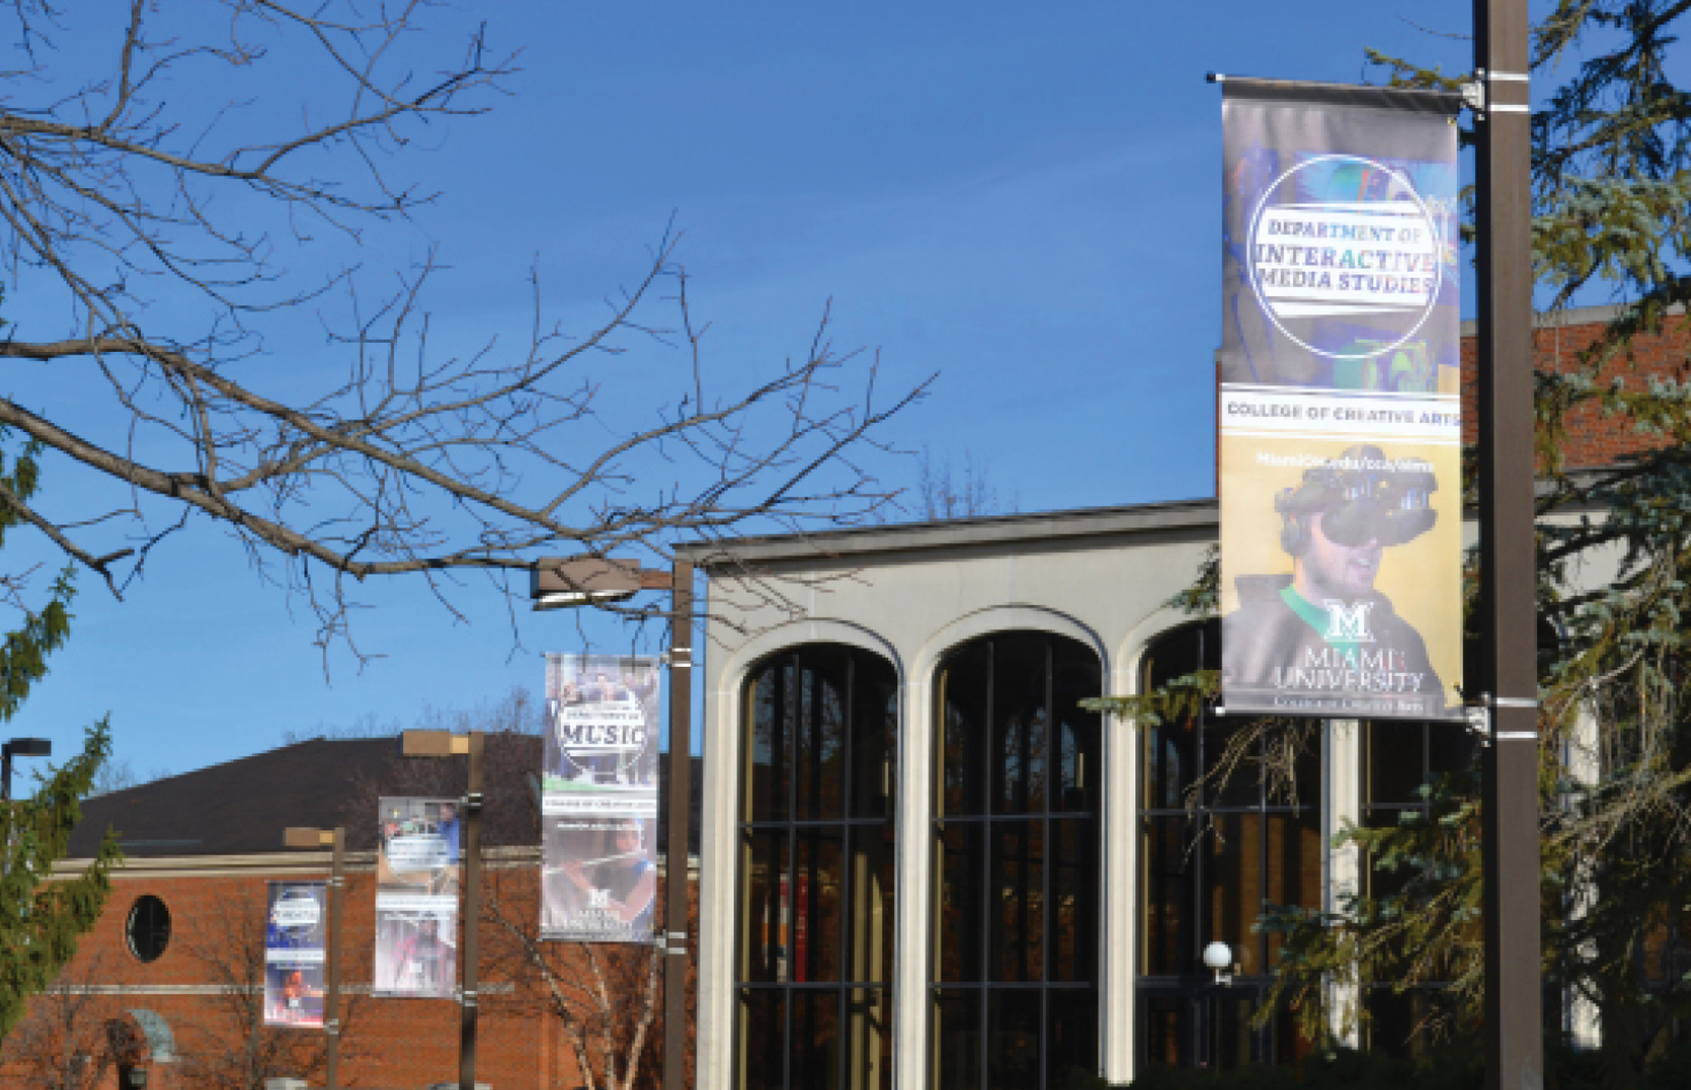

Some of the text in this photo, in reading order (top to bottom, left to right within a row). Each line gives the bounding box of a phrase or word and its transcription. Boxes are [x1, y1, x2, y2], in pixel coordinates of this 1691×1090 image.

[1268, 219, 1423, 244] DEPARTMENT OF
[1256, 244, 1436, 272] INTERACTIVE
[1259, 268, 1436, 294] MEDIA STUDIES
[1228, 400, 1461, 427] COLLEGE OF CREATIVE ARTS
[1324, 598, 1376, 642] M
[1304, 646, 1398, 671] MIAMI
[1274, 666, 1425, 692] UNIVERSITY
[563, 724, 645, 745] MUSIC
